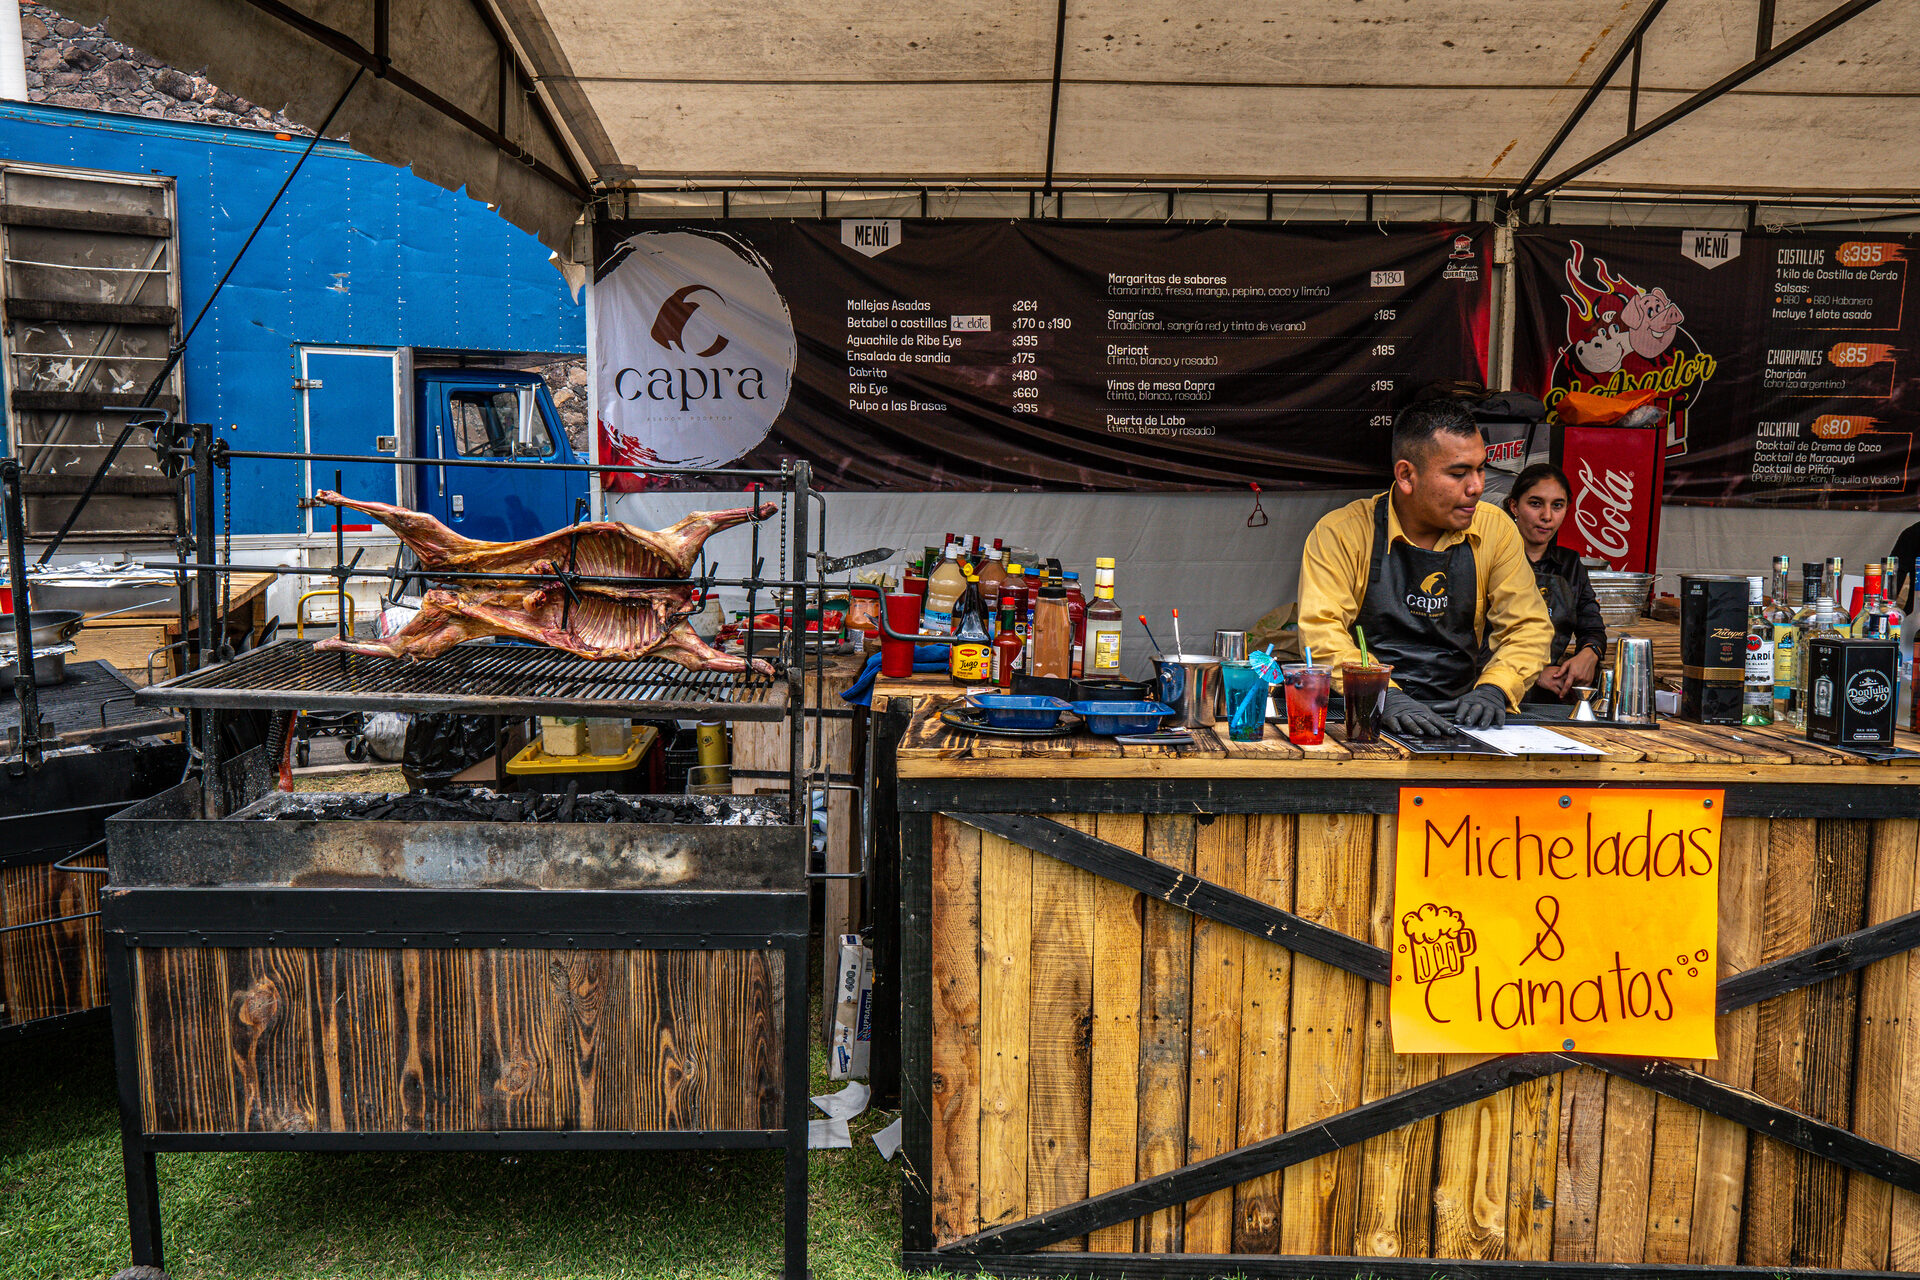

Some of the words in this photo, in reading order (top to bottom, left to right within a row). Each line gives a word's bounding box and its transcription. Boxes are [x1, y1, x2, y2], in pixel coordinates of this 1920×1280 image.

[855, 221, 888, 246] MENÚ
[1695, 233, 1728, 258] MENÚ
[1777, 248, 1825, 265] COSTILLAS
[1843, 245, 1882, 262] $395
[1108, 272, 1166, 286] Margaritas
[1168, 273, 1181, 284] de
[1184, 274, 1227, 285] sabores
[1373, 272, 1402, 285] $180
[1776, 268, 1780, 279] 1
[1783, 268, 1800, 279] kilo
[1802, 269, 1814, 279] de
[1816, 269, 1853, 280] Costilla
[1855, 270, 1867, 280] de
[1870, 270, 1898, 280] Cerdo
[1107, 285, 1163, 296] (tamarindo,
[1166, 286, 1194, 296] fresa,
[1196, 287, 1230, 298] mango,
[1232, 286, 1266, 298] pepino,
[1268, 287, 1291, 296] coco
[1292, 287, 1299, 298] y
[1301, 286, 1330, 297] limón)
[1774, 282, 1810, 293] Salsas:
[847, 300, 889, 312] Mollejas
[891, 300, 931, 311] Asadas
[1012, 300, 1038, 311] $264
[1832, 295, 1873, 306] Habanero
[1107, 309, 1155, 322] Sangrías
[1374, 309, 1396, 320] $185
[1772, 308, 1806, 320] Incluye
[1808, 308, 1813, 319] 1
[1815, 309, 1840, 319] elote
[1842, 309, 1872, 320] asado
[847, 316, 888, 328] Betabel
[890, 320, 898, 328] o
[900, 317, 947, 328] costillas
[966, 316, 989, 329] elote
[1012, 318, 1036, 329] $170
[1038, 320, 1045, 329] o
[1047, 318, 1072, 329] $190
[1107, 321, 1165, 331] (Tradicional,
[1167, 321, 1203, 332] sangría
[1204, 321, 1221, 331] red
[1222, 323, 1229, 332] y
[1231, 321, 1254, 331] tinto
[1256, 321, 1269, 331] de
[1270, 321, 1306, 332] verano)
[847, 334, 898, 347] Aguachile
[900, 334, 914, 345] de
[916, 335, 940, 346] Ribe
[942, 335, 962, 348] Eye
[1012, 336, 1038, 347] $395
[1107, 345, 1149, 355] Clericot
[1372, 345, 1395, 356] $185
[1839, 347, 1867, 363] $85
[847, 350, 896, 361] Ensalada
[899, 352, 912, 363] de
[914, 352, 951, 363] sandia
[1012, 353, 1035, 364] $175
[1106, 356, 1138, 366] (Tinto,
[1140, 356, 1171, 365] blanco
[1173, 357, 1180, 367] y
[1181, 356, 1218, 366] rosado)
[1767, 349, 1823, 366] CHORIPANES
[849, 366, 888, 378] Cabrito
[1012, 370, 1037, 381] $480
[1764, 368, 1807, 380] Choripán
[614, 367, 769, 412] capra
[849, 383, 866, 394] Rib
[869, 384, 888, 396] Eye
[1106, 380, 1135, 391] Vinos
[1137, 380, 1150, 391] de
[1153, 381, 1181, 391] mesa
[1184, 380, 1215, 392] Capra
[1370, 380, 1394, 392] $195
[1763, 379, 1799, 389] (chorizo
[1800, 379, 1846, 390] argentino)
[1012, 387, 1038, 398] $660
[1106, 391, 1137, 401] (tinto,
[1139, 391, 1173, 401] blanco,
[1175, 391, 1211, 401] rosado)
[849, 399, 878, 412] Pulpo
[881, 402, 888, 411] a
[891, 400, 908, 411] las
[910, 400, 947, 411] Brasas
[1012, 403, 1038, 413] $395
[1106, 414, 1142, 426] Puerta
[1145, 415, 1157, 426] de
[1160, 415, 1186, 426] Lobo
[1369, 415, 1392, 427] $215
[1107, 425, 1137, 434] (tinto,
[1138, 426, 1169, 436] blanco
[1171, 428, 1178, 437] y
[1179, 426, 1216, 436] rosado)
[1757, 421, 1800, 437] COCKTAIL
[1822, 419, 1851, 435] $80
[1485, 439, 1526, 463] CATE
[1756, 440, 1795, 451] Cocktail
[1797, 441, 1809, 451] de
[1811, 441, 1842, 452] Crema
[1843, 442, 1855, 452] de
[1857, 442, 1882, 452] Coco
[1754, 451, 1794, 462] Cocktail
[1795, 452, 1807, 463] de
[1809, 453, 1855, 465] Maracuyá
[1752, 463, 1792, 474] Cocktail
[1794, 464, 1806, 474] de
[1808, 464, 1835, 474] Piñón
[1751, 473, 1781, 483] (Puede
[1831, 475, 1861, 485] Tequila
[1870, 475, 1900, 485] Vodka)
[1745, 650, 1771, 660] CARDÍ
[959, 660, 978, 671] Jugo
[1873, 693, 1887, 701] 70
[1424, 808, 1713, 881] Micheladas
[1519, 895, 1565, 966] &
[1424, 951, 1673, 1030] Clamatos
